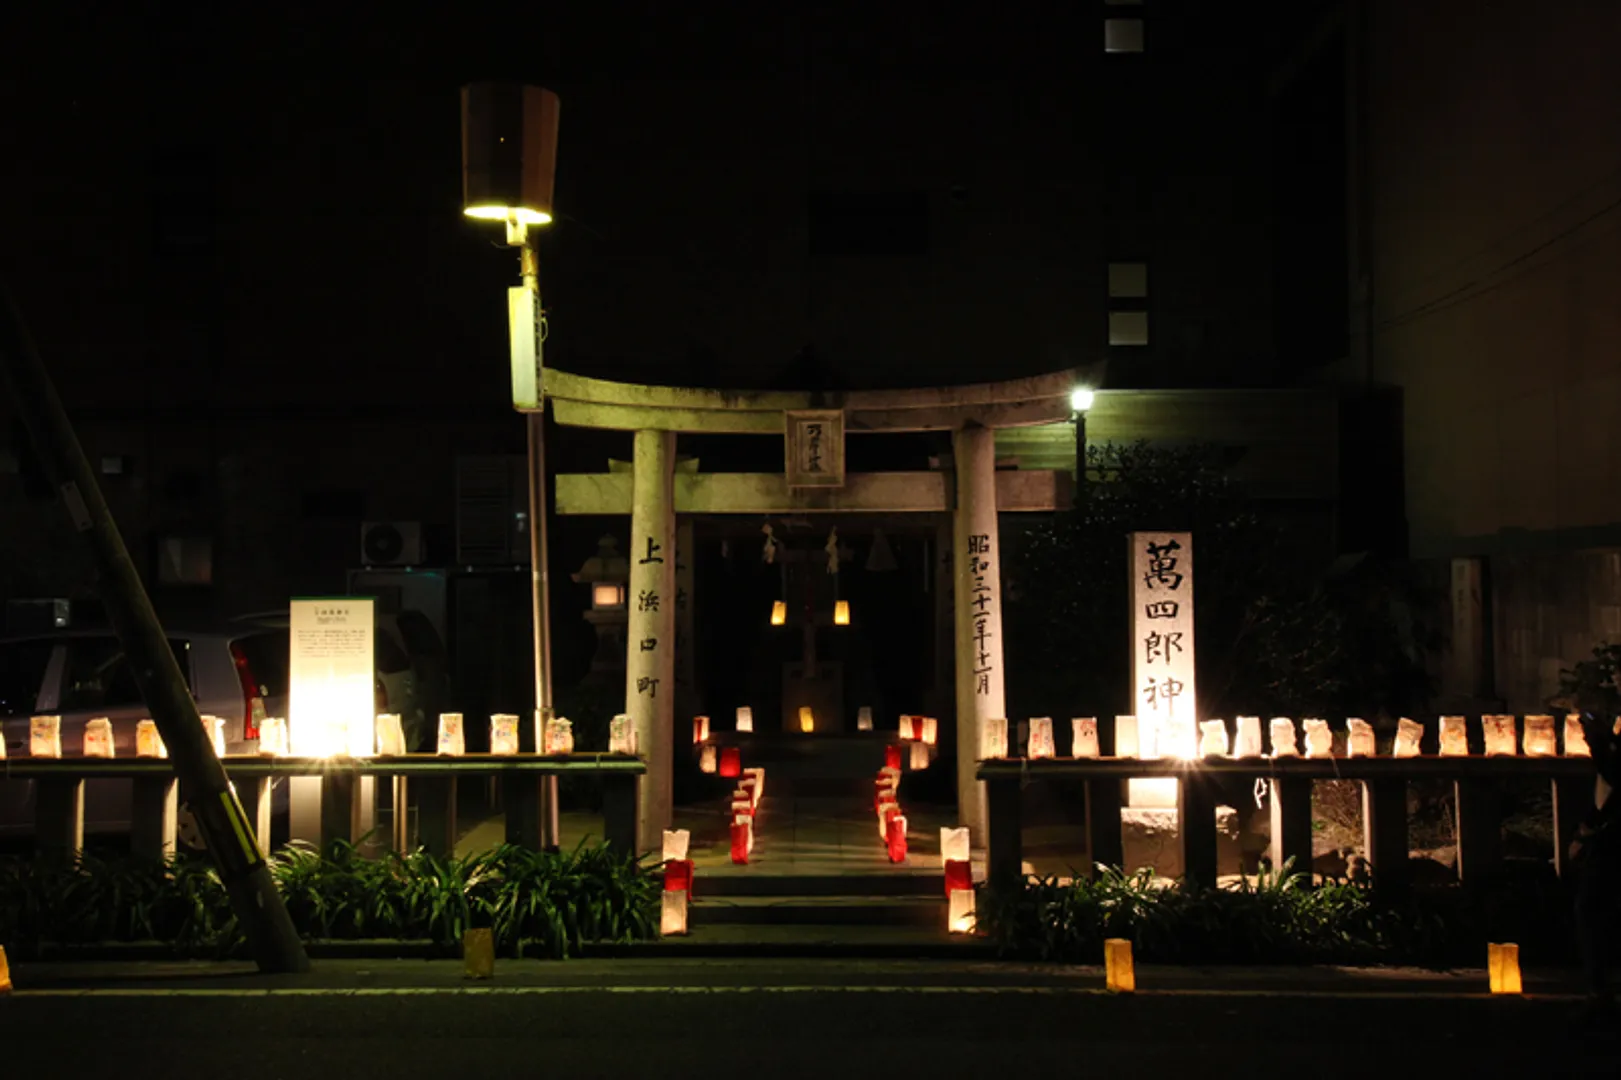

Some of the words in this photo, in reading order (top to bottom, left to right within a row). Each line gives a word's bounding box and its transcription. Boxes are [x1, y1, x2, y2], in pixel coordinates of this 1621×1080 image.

[636, 536, 664, 699] 上浜口町
[1143, 538, 1184, 756] 萬四郎神
